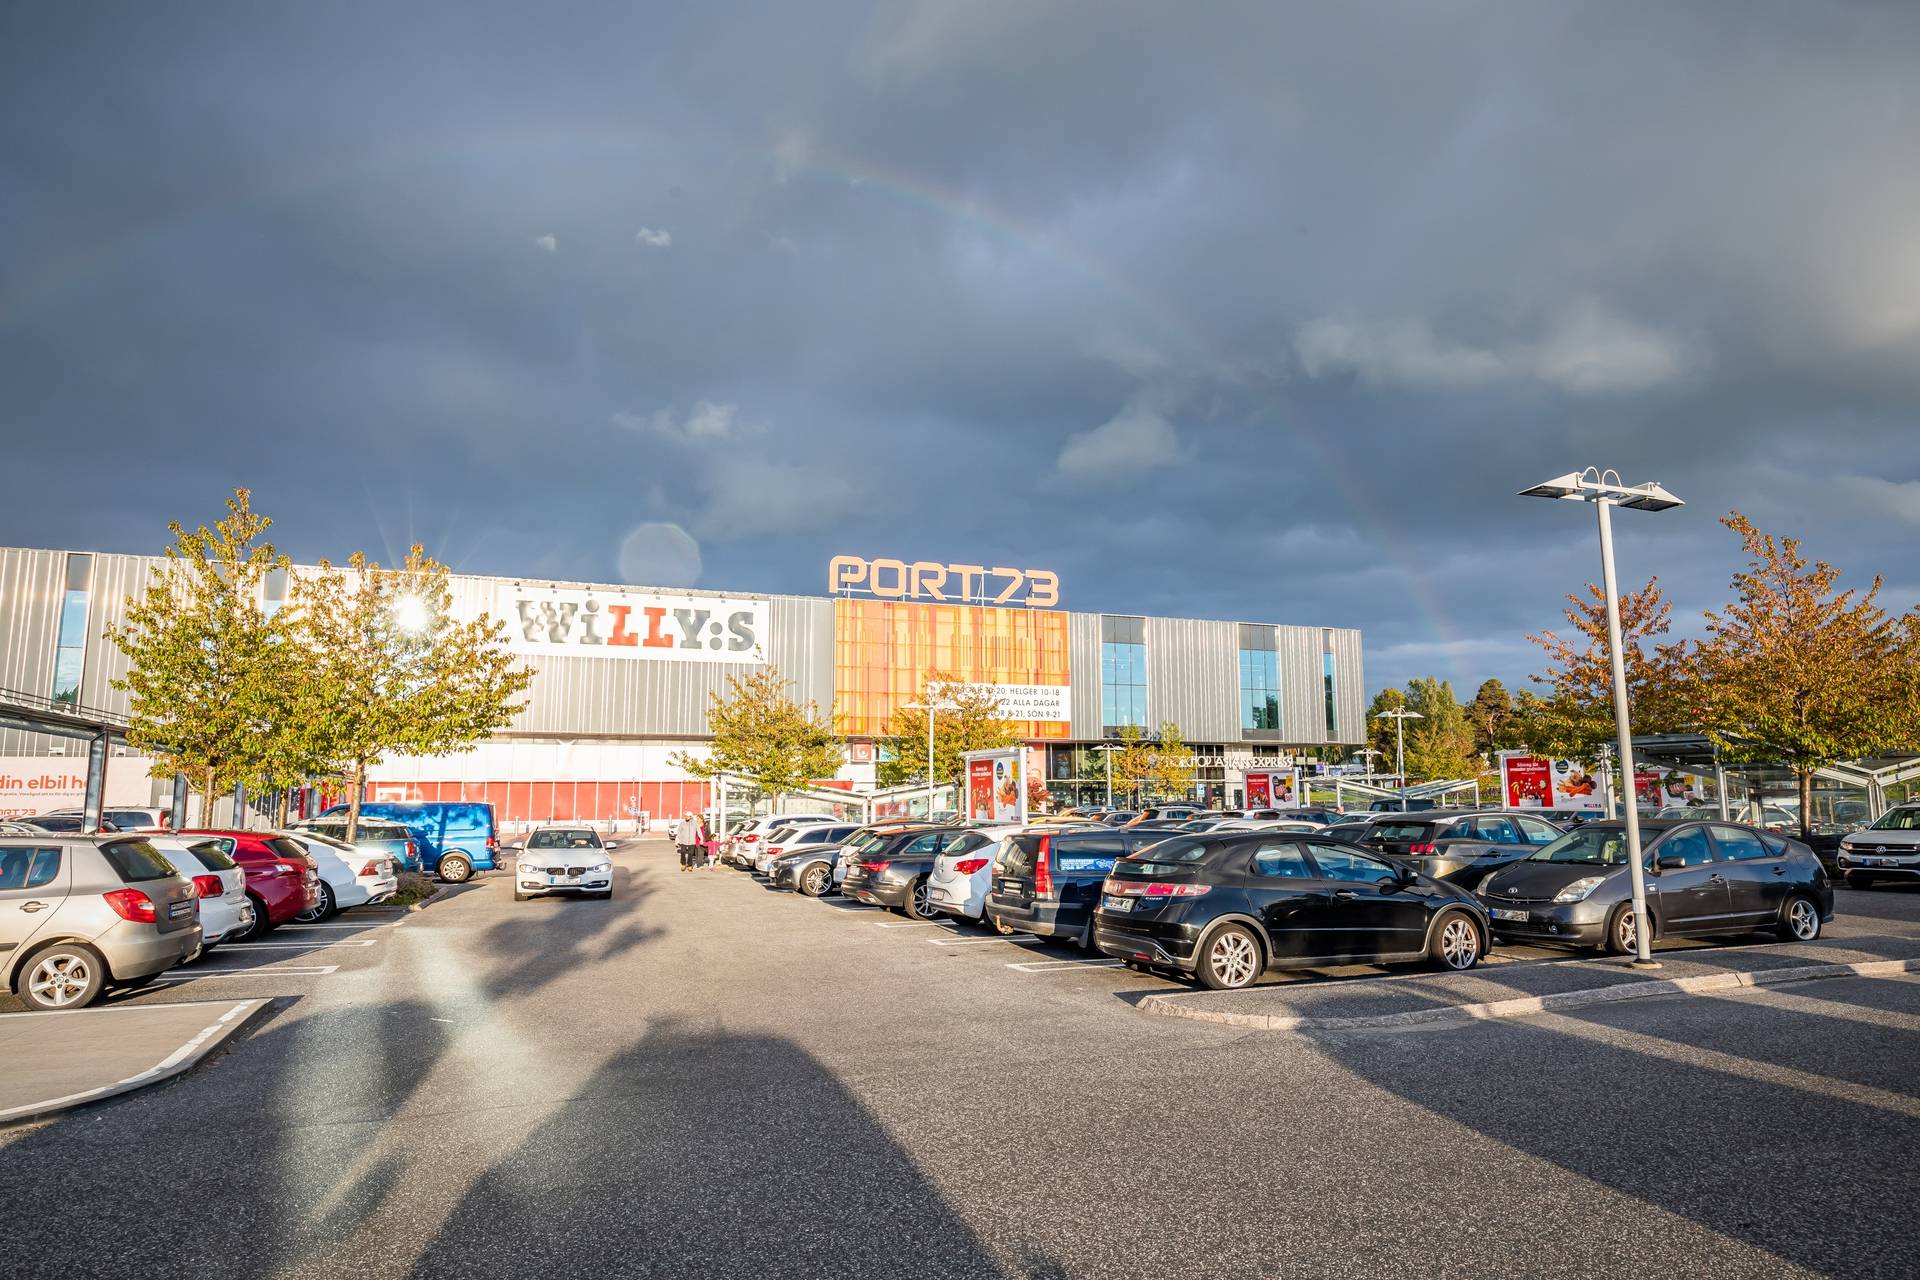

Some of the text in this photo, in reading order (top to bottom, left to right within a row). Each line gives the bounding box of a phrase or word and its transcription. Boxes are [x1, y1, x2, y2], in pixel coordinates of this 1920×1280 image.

[829, 555, 1059, 607] PORT 73
[1010, 688, 1038, 696] HELGER
[1041, 689, 1060, 697] 10-18
[1034, 699, 1060, 707] DAGAR
[1046, 710, 1061, 719] 9-21
[1253, 756, 1294, 768] EXPRESS
[28, 775, 67, 789] elbil
[21, 808, 37, 816] 73
